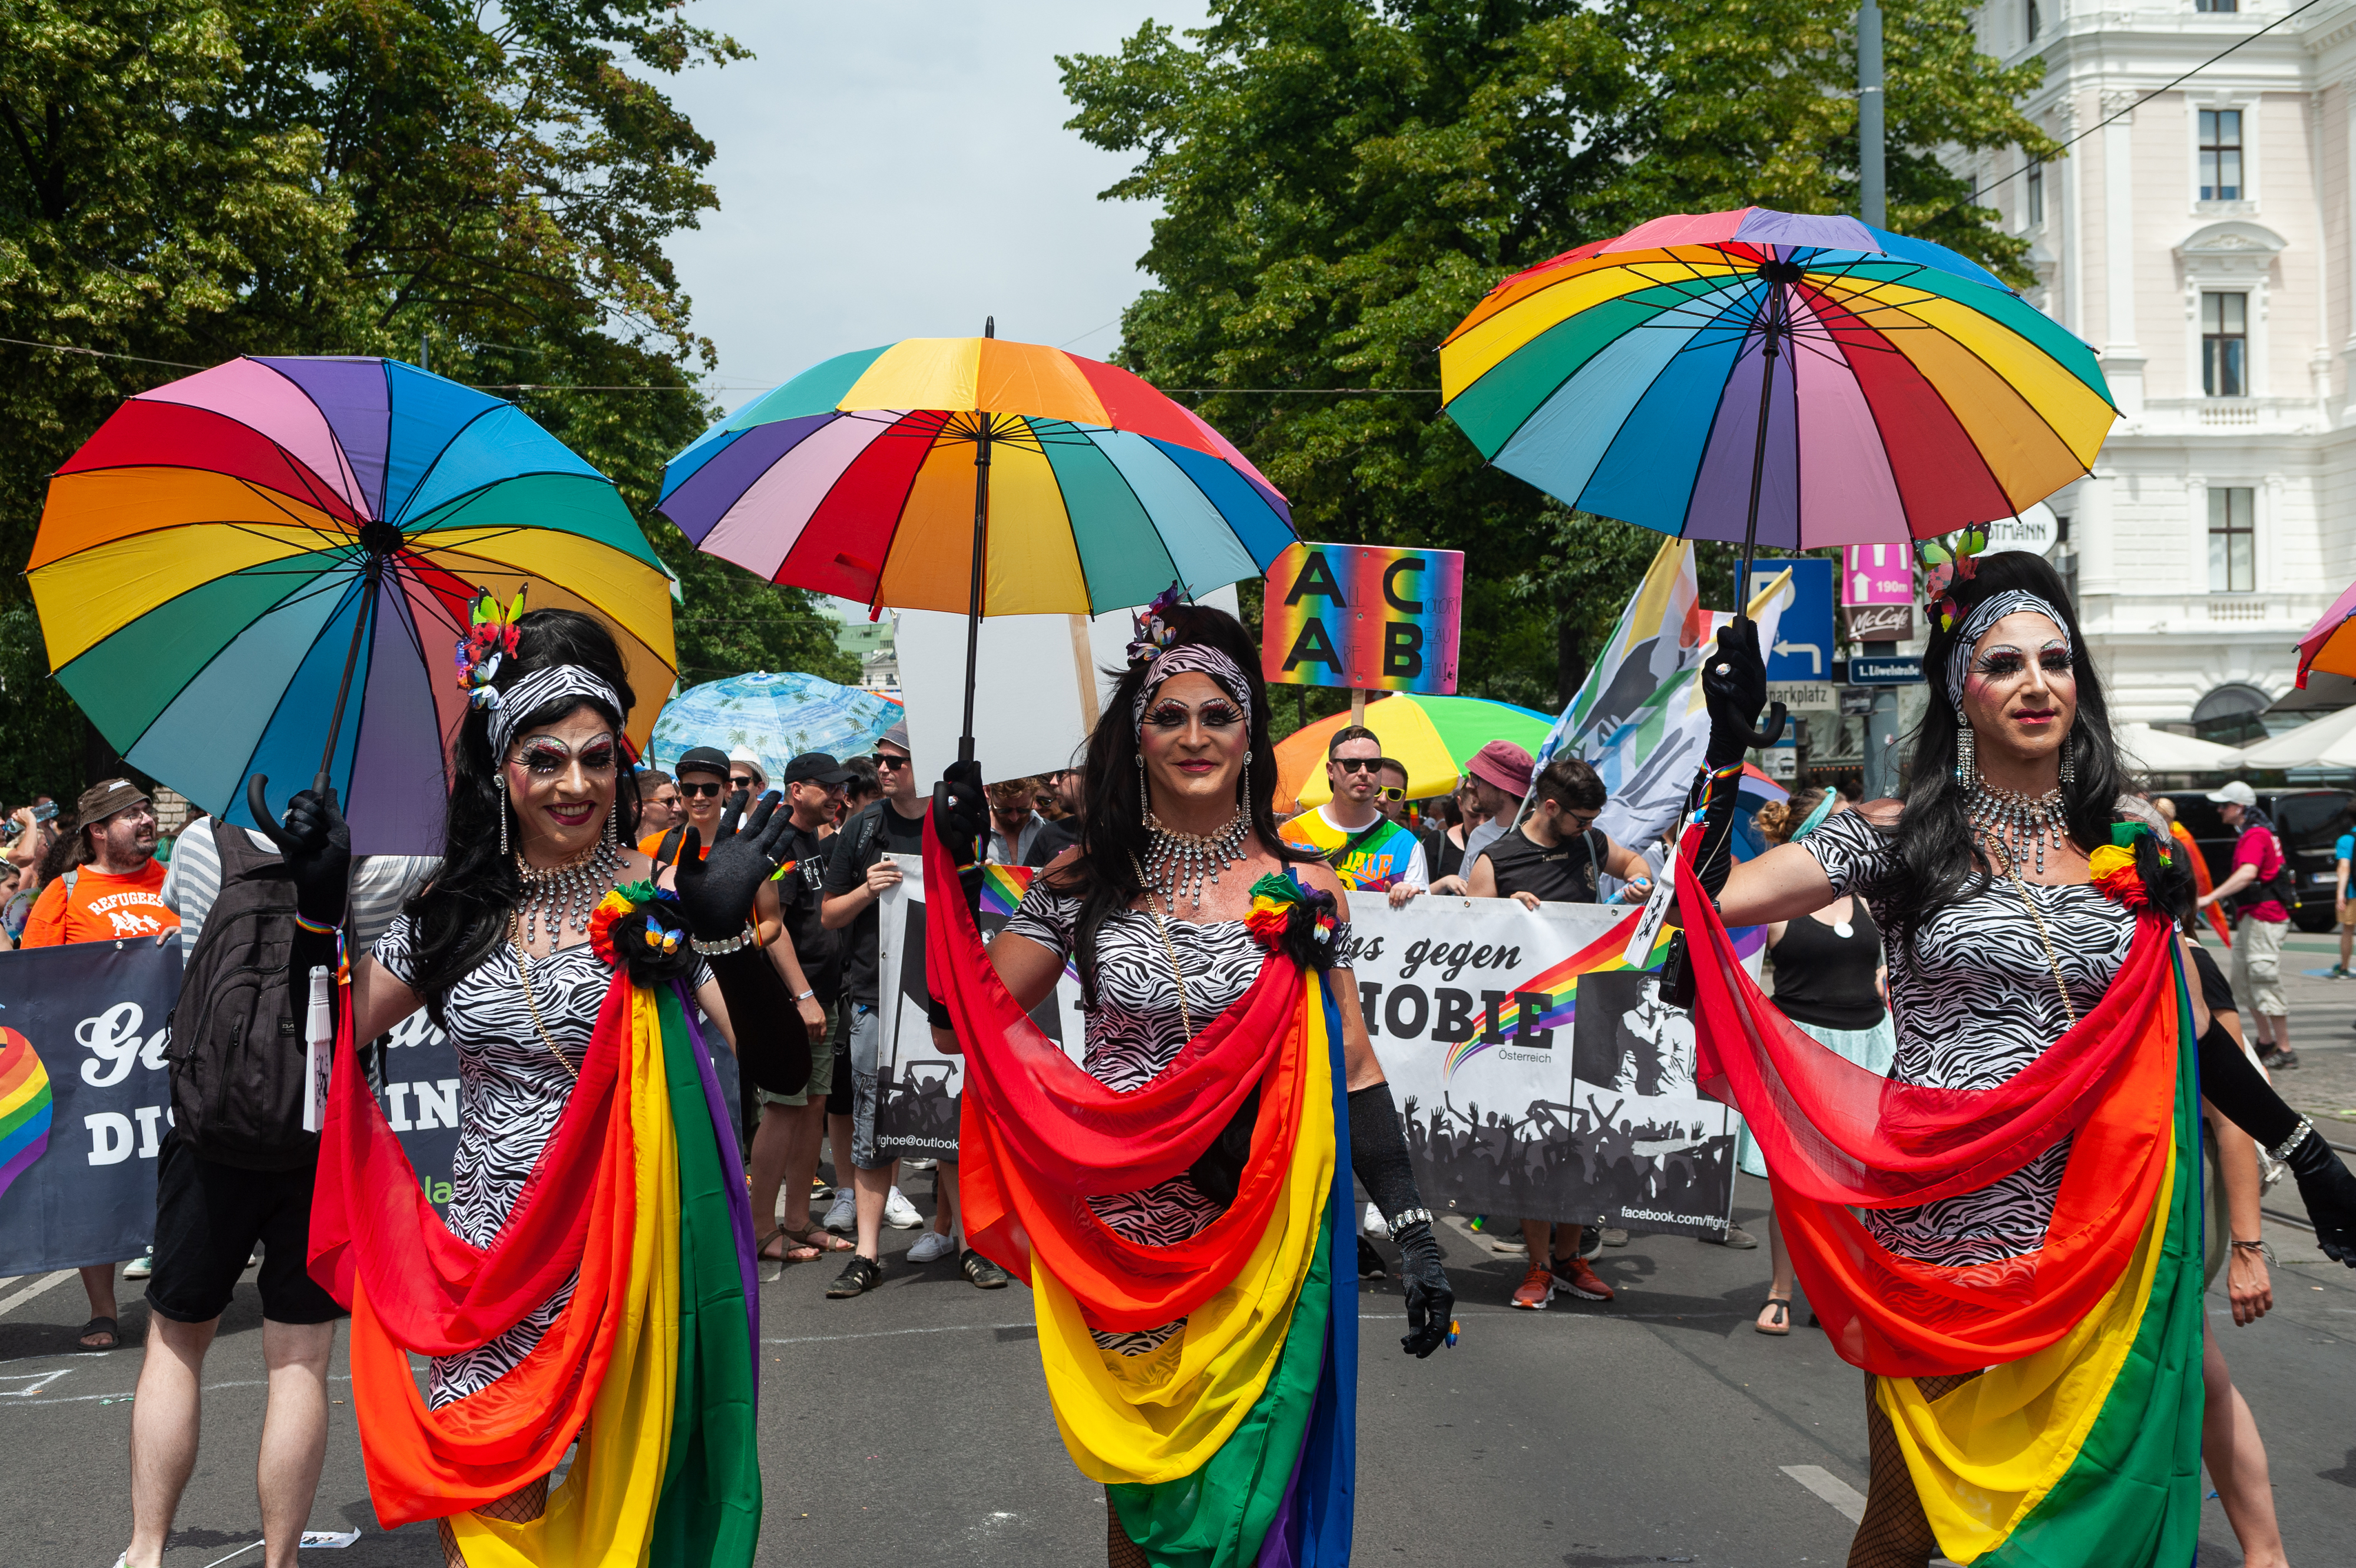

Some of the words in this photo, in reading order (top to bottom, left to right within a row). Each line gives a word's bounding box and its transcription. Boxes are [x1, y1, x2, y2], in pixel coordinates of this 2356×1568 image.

[1876, 580, 1908, 593] 190m
[1766, 684, 1828, 707] parkplatz
[88, 892, 164, 915] REFUGEES
[1399, 938, 1522, 982] gegen
[1498, 1048, 1552, 1064] Österreich
